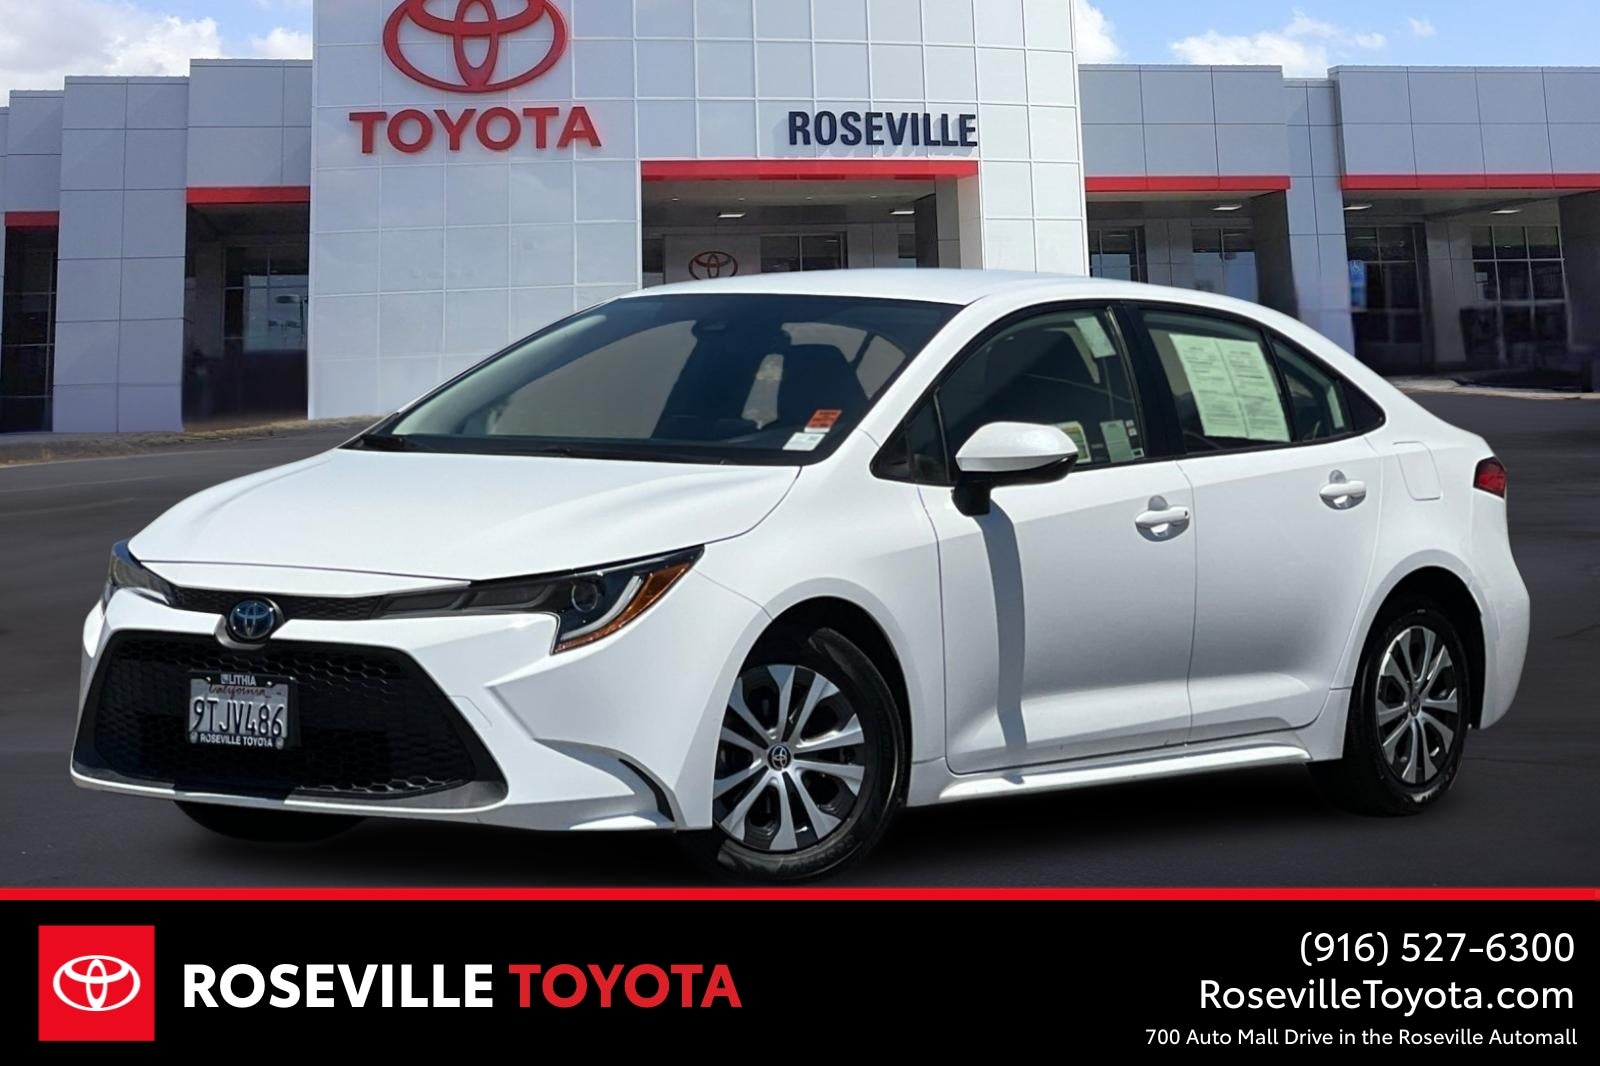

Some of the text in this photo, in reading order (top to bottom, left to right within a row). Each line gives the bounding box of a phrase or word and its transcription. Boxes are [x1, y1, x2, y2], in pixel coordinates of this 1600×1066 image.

[349, 106, 602, 154] TOYOTA
[788, 111, 978, 147] ROSEVILLE
[229, 673, 256, 686] LITHIA
[192, 696, 285, 737] 9TJV486
[200, 733, 241, 745] ROSEVILLE
